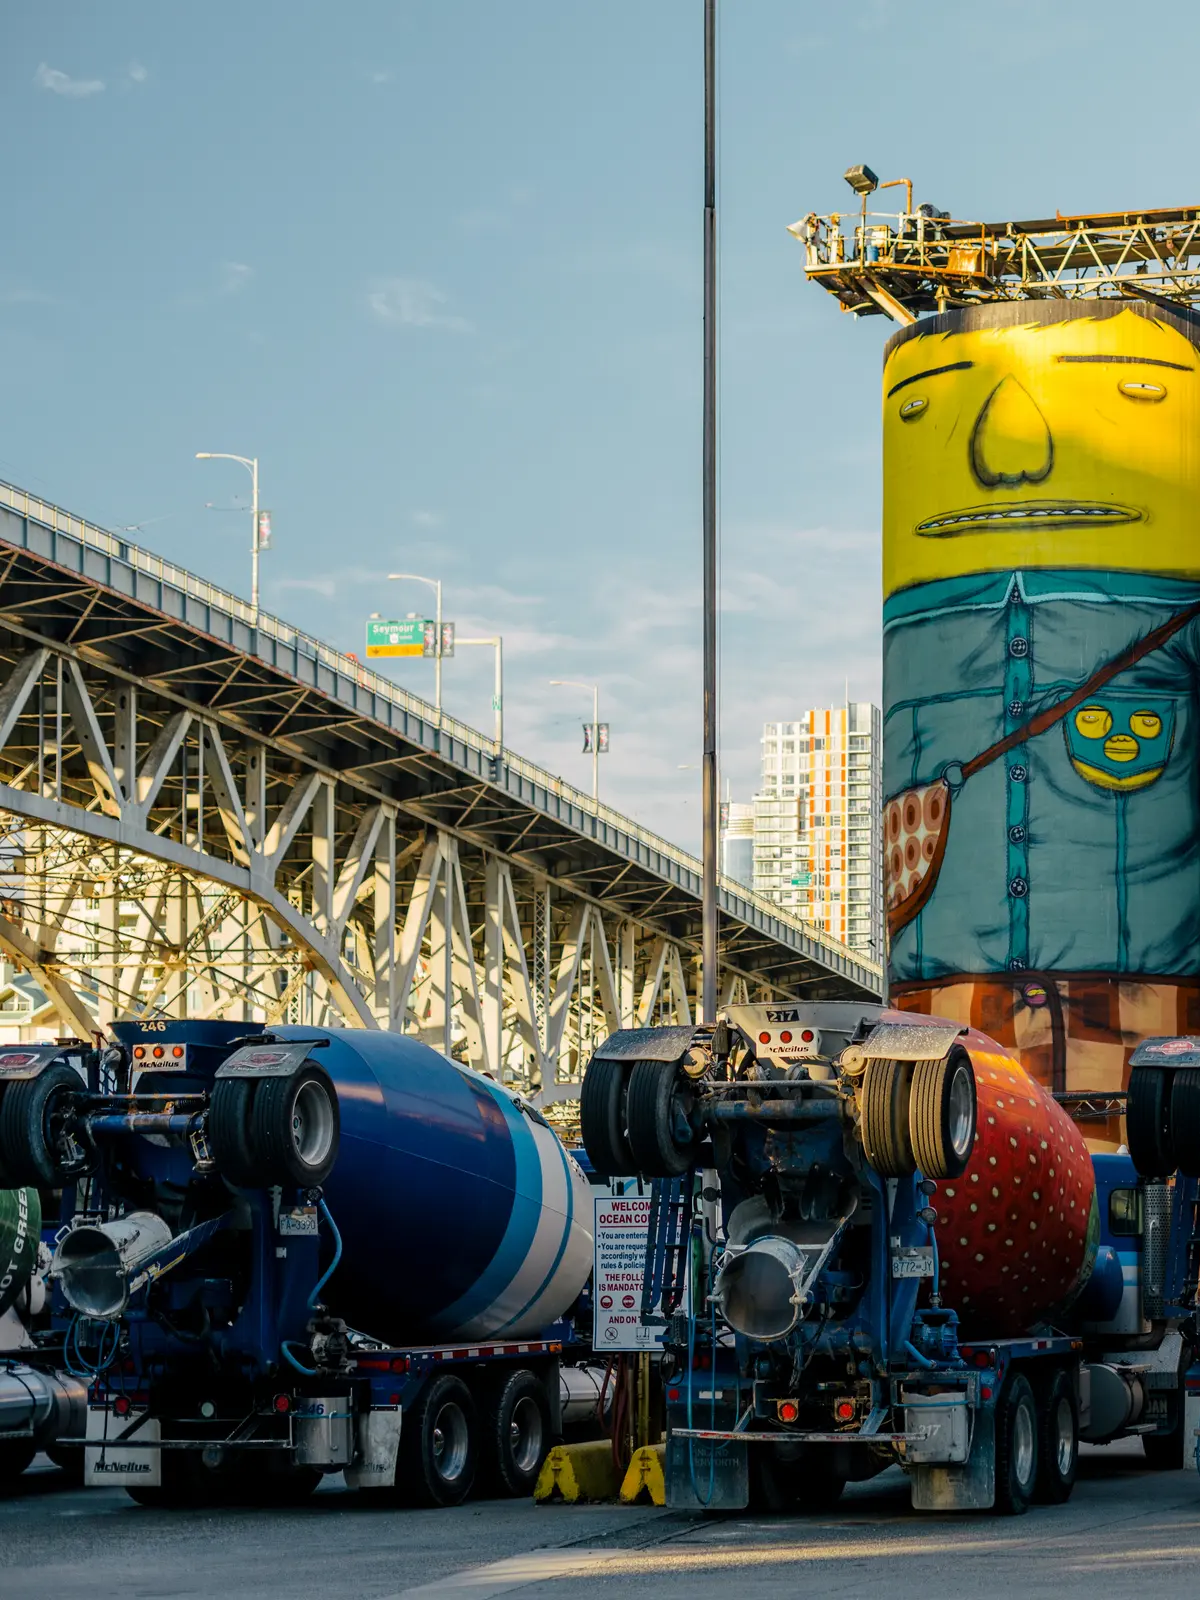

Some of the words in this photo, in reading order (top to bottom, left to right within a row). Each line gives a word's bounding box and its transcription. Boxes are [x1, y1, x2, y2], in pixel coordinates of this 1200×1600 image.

[373, 624, 414, 634] Seymour
[769, 1011, 794, 1022] 217
[141, 1021, 166, 1032] 246
[612, 1202, 652, 1211] WELCOM
[600, 1214, 632, 1223] OCEAN
[919, 1425, 941, 1436] 217
